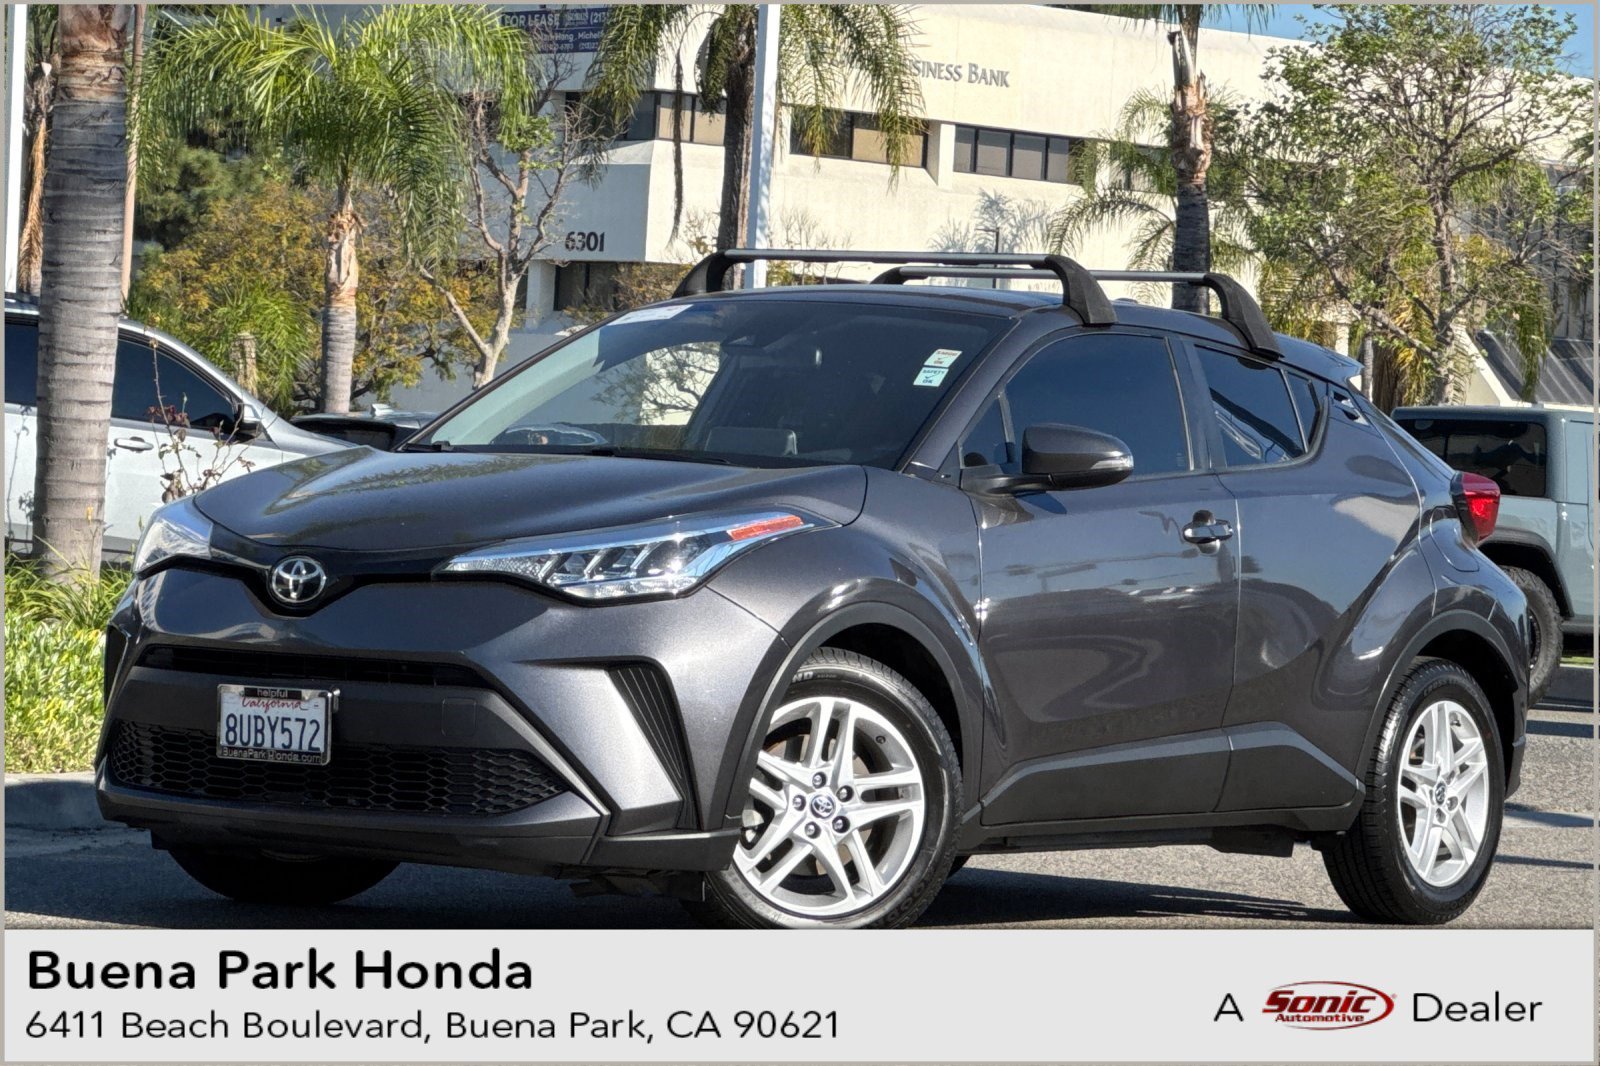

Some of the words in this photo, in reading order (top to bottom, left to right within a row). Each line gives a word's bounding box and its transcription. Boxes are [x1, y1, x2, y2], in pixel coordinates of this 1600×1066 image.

[504, 14, 526, 27] FOR
[528, 12, 560, 27] LEASE
[911, 60, 963, 82] SINESS
[967, 62, 1010, 88] BANK
[565, 231, 605, 252] 6301
[256, 687, 288, 697] helpful
[241, 696, 309, 713] California
[225, 713, 321, 752] 8UBY572
